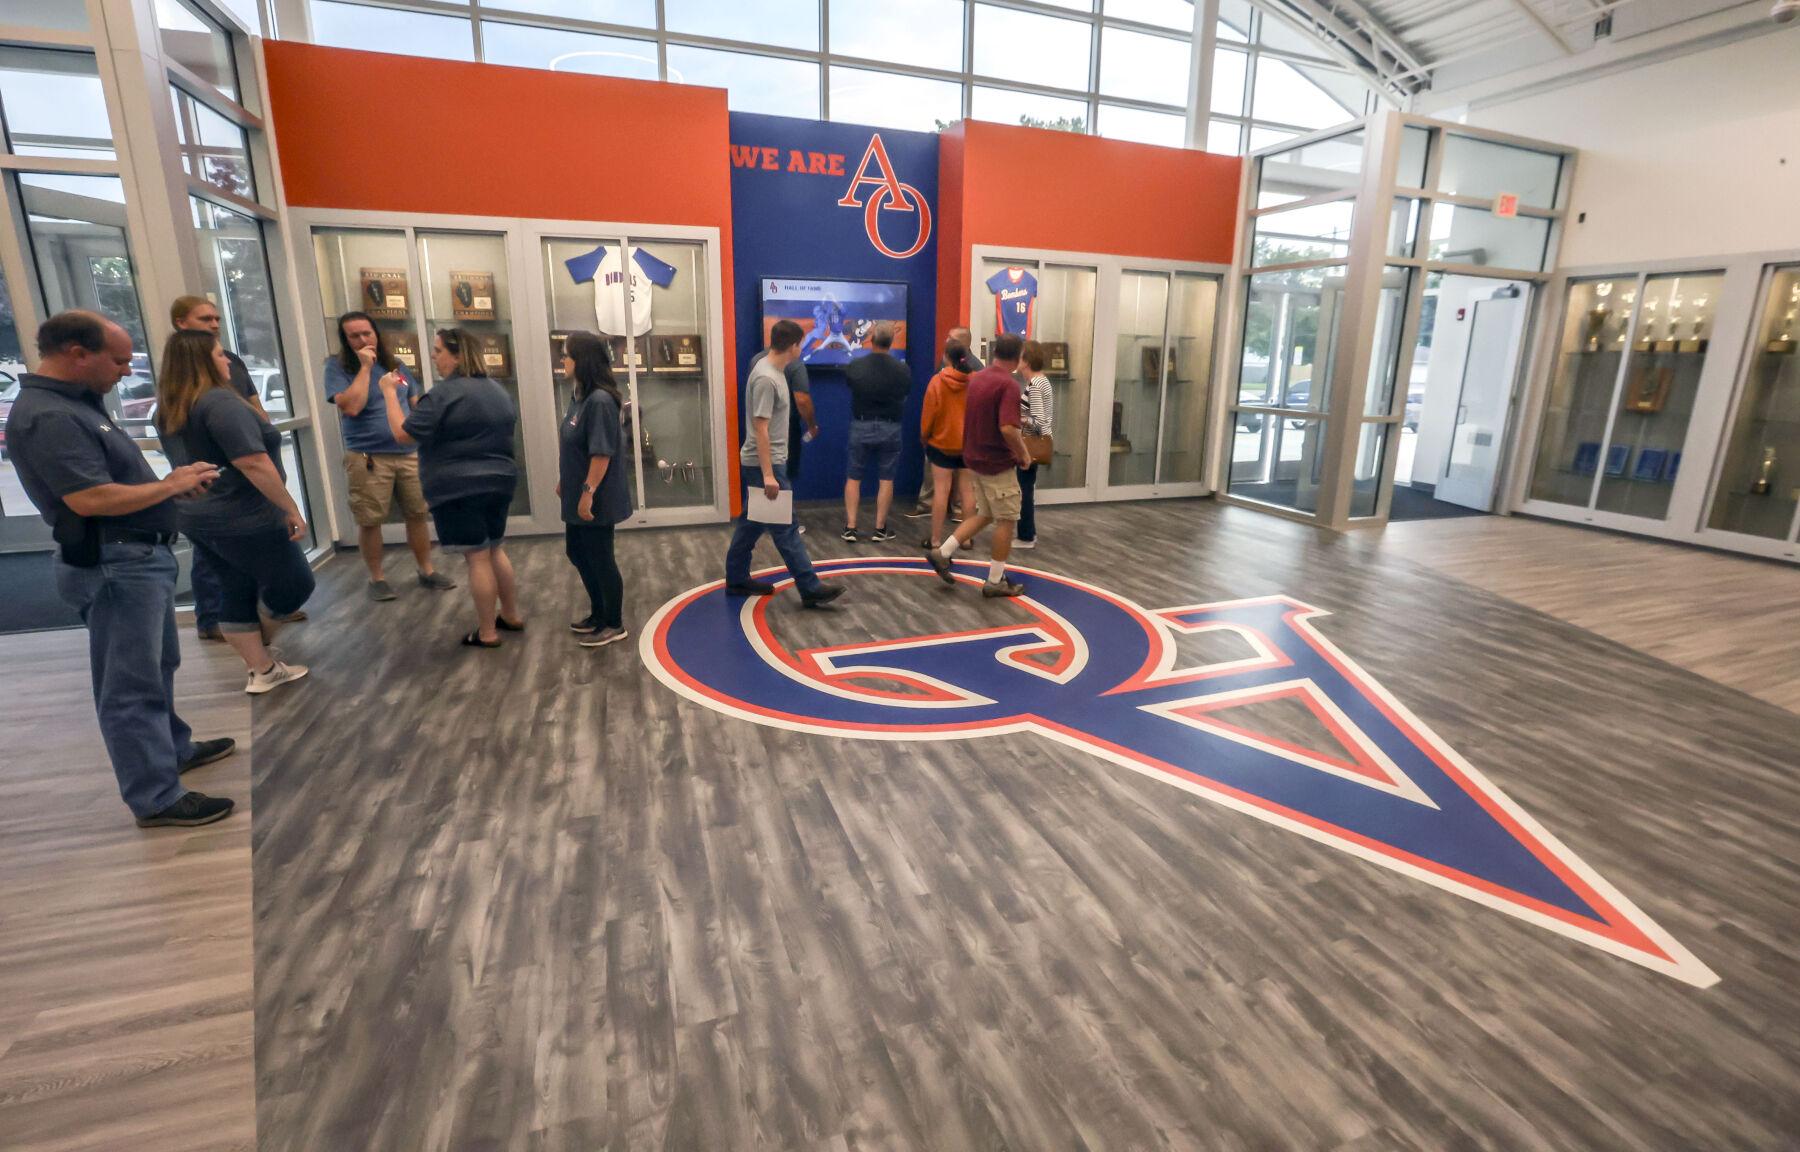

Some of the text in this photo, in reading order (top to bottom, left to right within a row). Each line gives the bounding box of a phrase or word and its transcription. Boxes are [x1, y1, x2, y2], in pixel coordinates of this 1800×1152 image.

[730, 133, 932, 259] WE ARE AO
[1001, 288, 1028, 300] Bombers
[1016, 302, 1026, 313] 16
